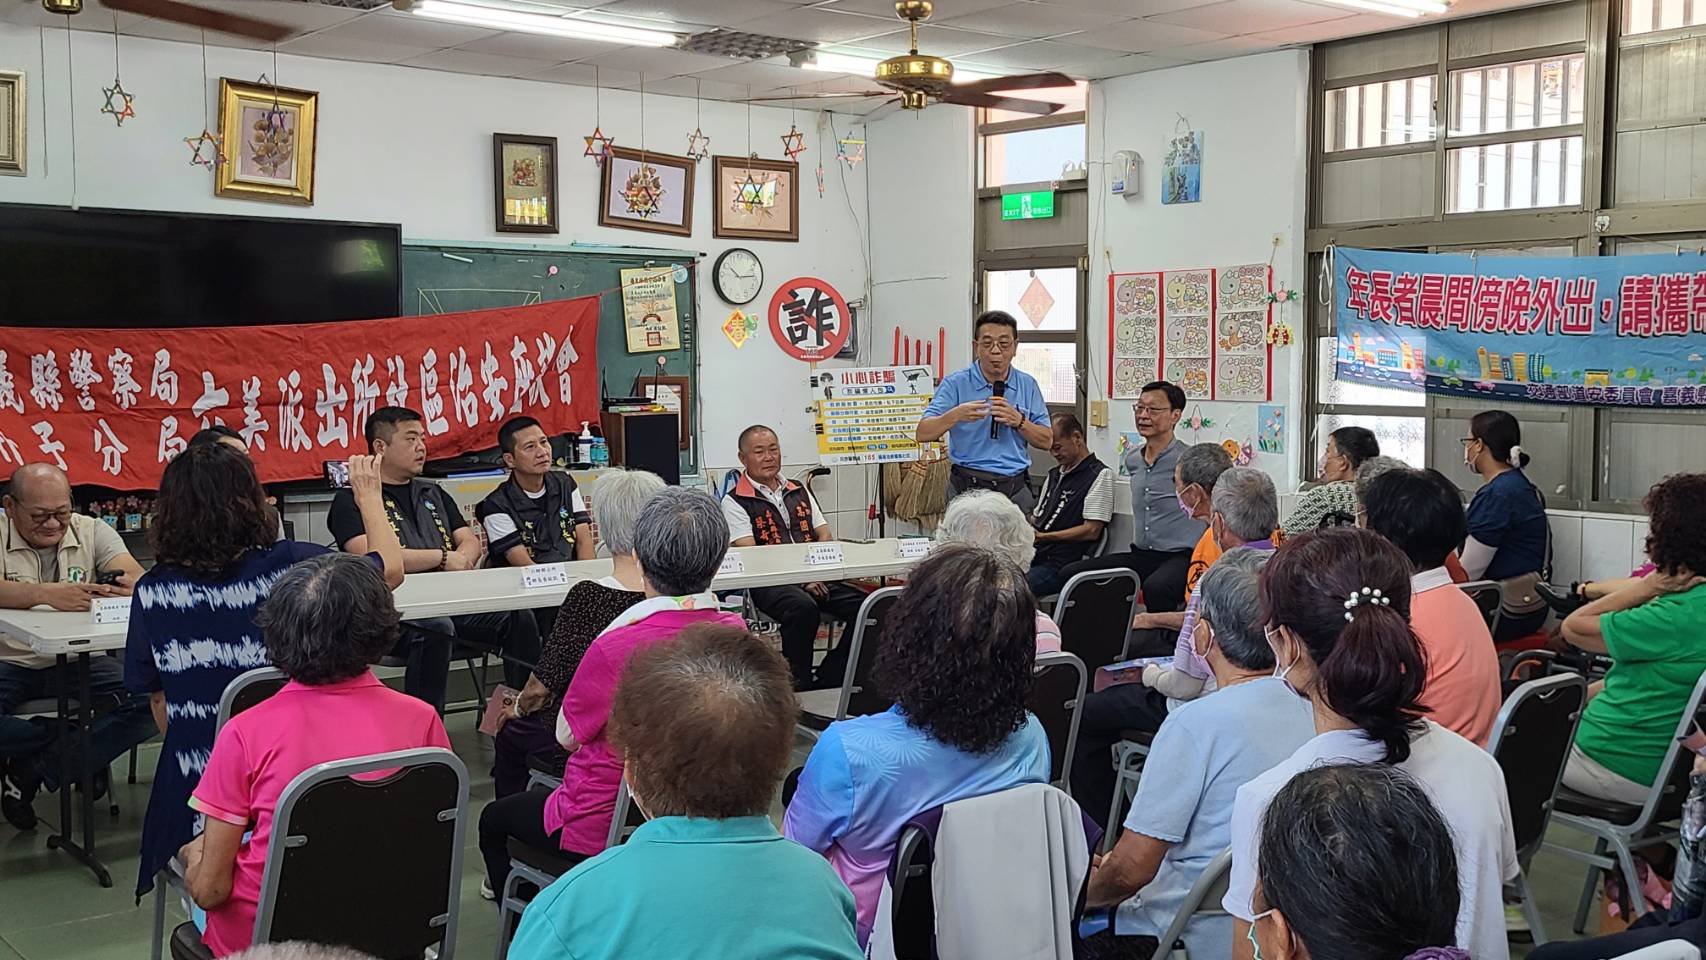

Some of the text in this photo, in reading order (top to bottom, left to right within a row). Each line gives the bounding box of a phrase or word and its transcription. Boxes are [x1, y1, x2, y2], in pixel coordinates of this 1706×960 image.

[782, 287, 835, 346] 詐
[841, 370, 896, 385] 小心詐騙
[1526, 383, 1654, 405] 交通部道安委員會
[863, 453, 876, 461] 165
